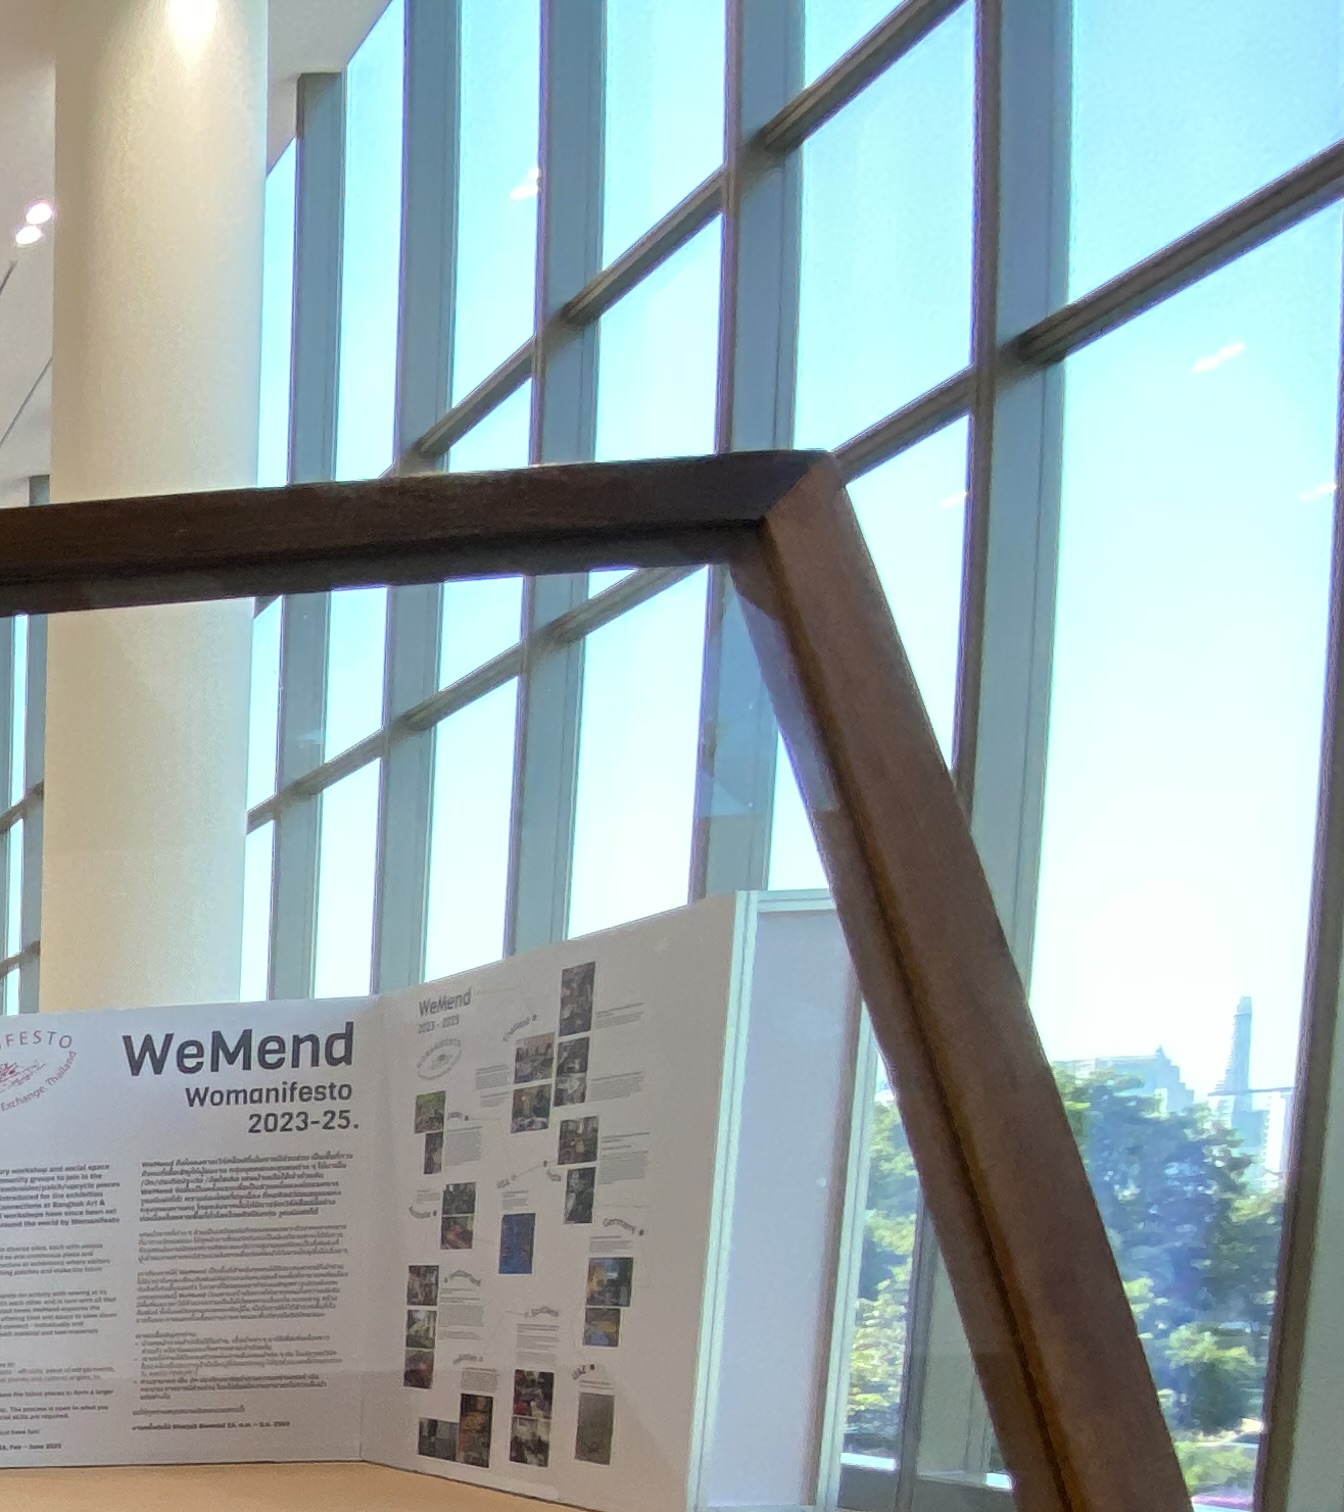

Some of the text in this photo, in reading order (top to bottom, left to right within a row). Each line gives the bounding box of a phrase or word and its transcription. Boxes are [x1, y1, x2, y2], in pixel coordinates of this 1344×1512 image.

[418, 988, 472, 1017] WeMend
[122, 1021, 354, 1077] WeMend
[45, 1051, 77, 1086] Thailand
[185, 1081, 353, 1107] Womanifesto
[248, 1110, 360, 1134] 2023-25.
